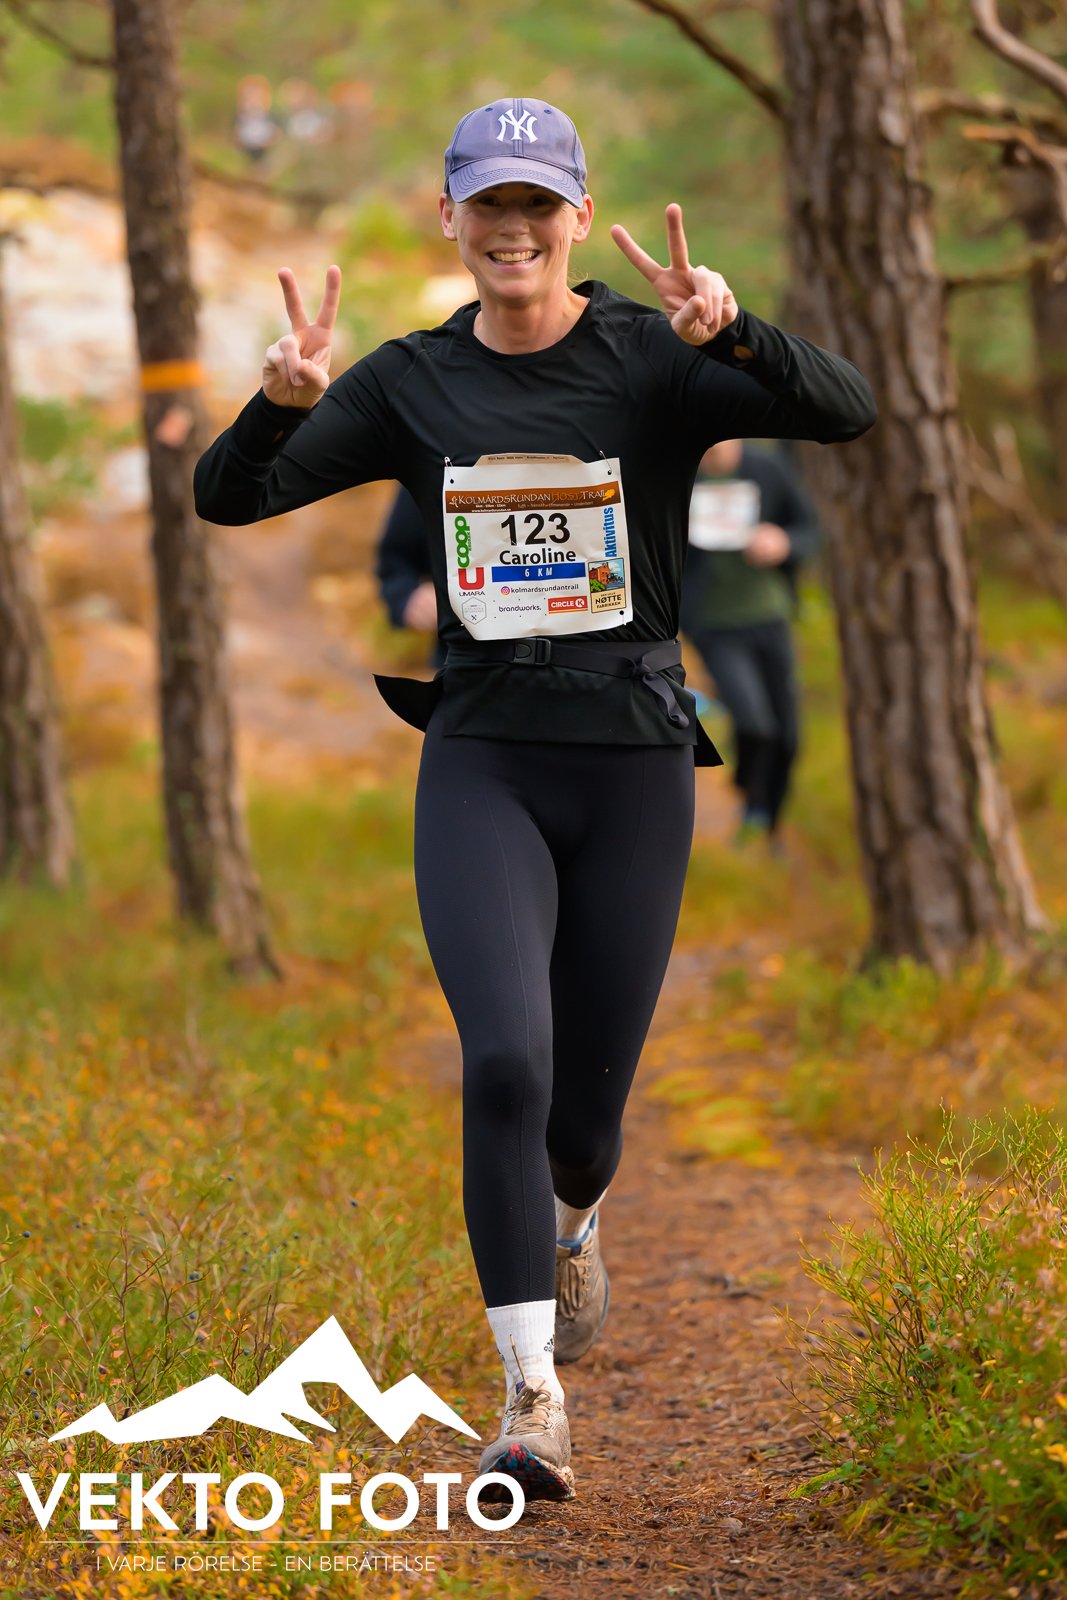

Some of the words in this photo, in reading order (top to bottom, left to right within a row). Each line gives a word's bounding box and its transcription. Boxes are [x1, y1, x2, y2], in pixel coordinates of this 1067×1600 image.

[496, 108, 538, 143] NY
[501, 512, 570, 546] 123
[603, 507, 617, 557] Aktivitus
[500, 548, 576, 565] Caroline
[524, 568, 530, 577] 6
[551, 600, 574, 608] CIRCLE
[575, 599, 585, 608] K
